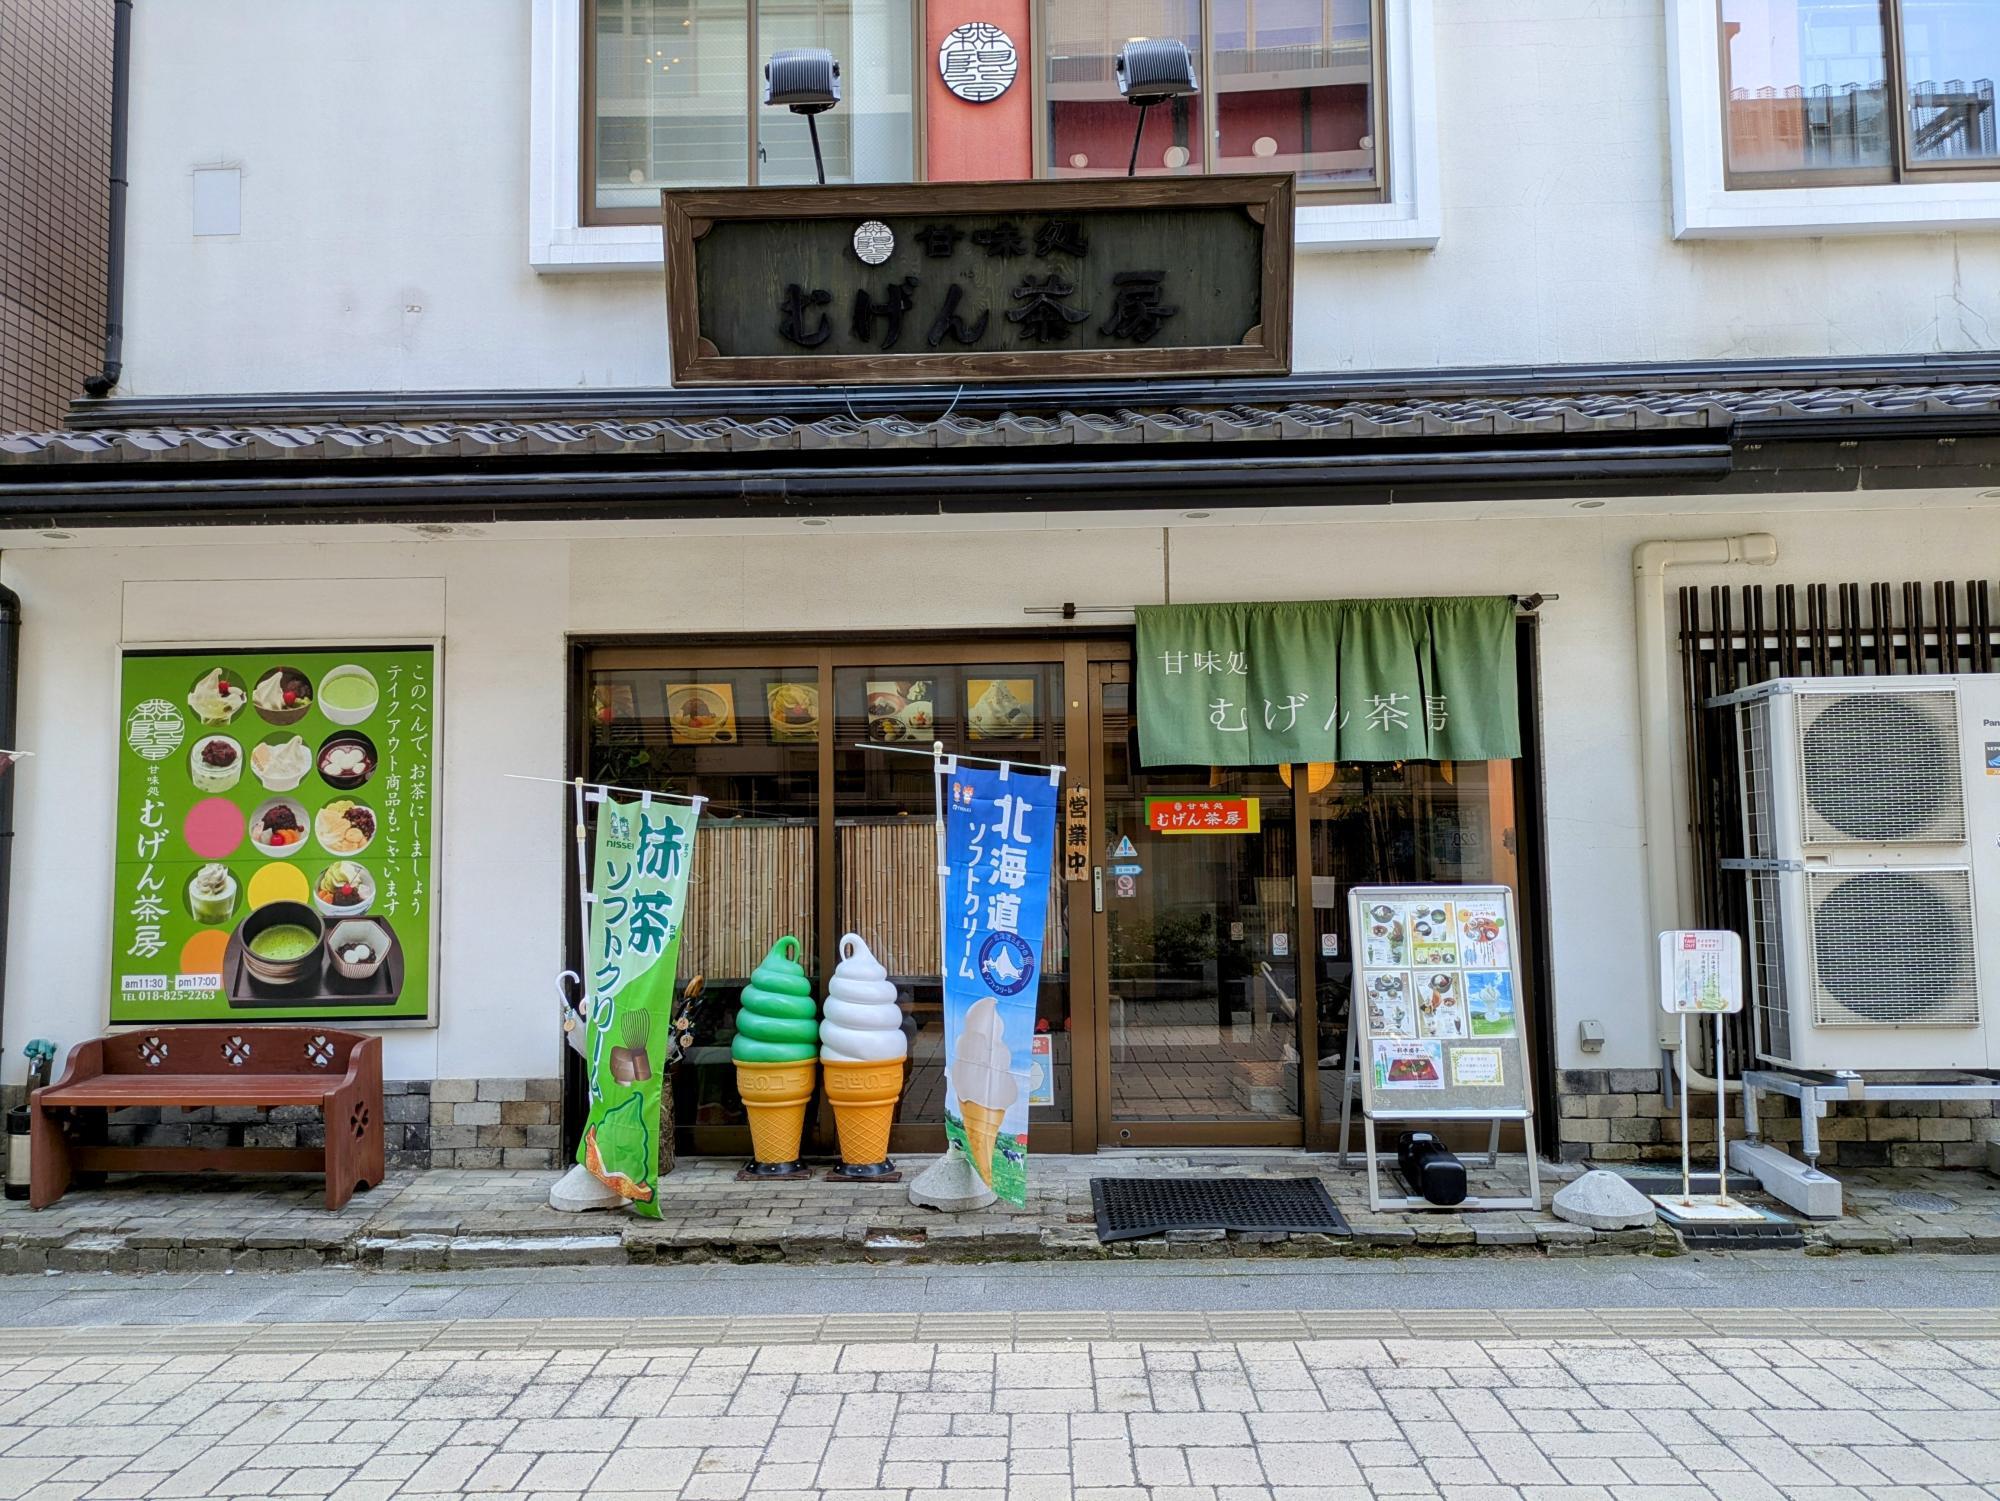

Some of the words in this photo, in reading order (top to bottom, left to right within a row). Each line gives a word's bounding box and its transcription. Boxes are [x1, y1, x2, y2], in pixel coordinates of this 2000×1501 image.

[914, 221, 1088, 258] 甘味処
[779, 269, 1181, 349] むげん茶房
[147, 764, 160, 797] 甘味処
[1157, 811, 1241, 827] むげん茶房
[987, 794, 1033, 934] 北海道
[1068, 796, 1088, 873] 営業中
[127, 799, 170, 959] むげん茶房
[628, 812, 686, 954] 抹茶
[959, 822, 986, 980] ソフトクリーム
[122, 993, 136, 1001] TEL
[138, 990, 215, 1000] 018-825-2263
[125, 978, 163, 988] am11:30
[178, 976, 217, 988] pm17:00
